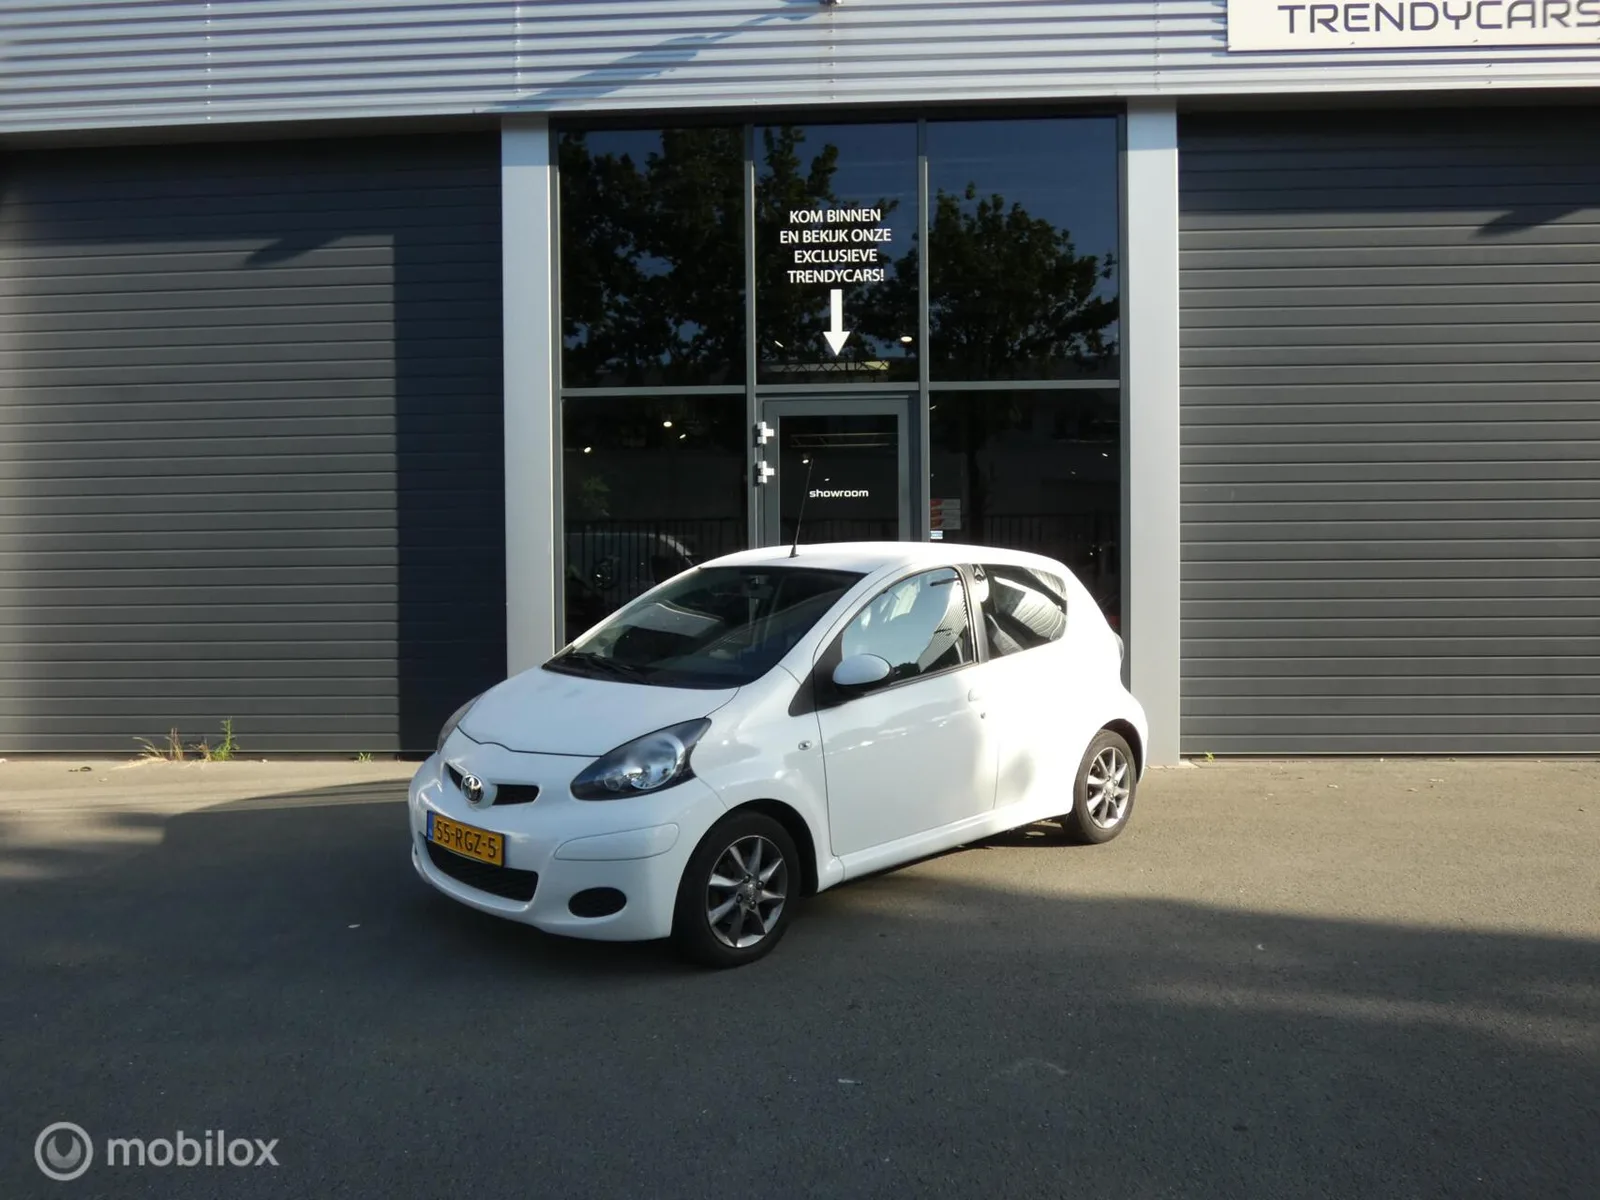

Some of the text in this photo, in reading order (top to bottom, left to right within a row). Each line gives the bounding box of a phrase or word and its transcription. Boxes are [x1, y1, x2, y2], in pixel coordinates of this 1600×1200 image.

[1277, 0, 1600, 34] TRENDYCARS
[789, 208, 881, 224] KOM BINNEN
[780, 228, 892, 244] EN BEKIJK ONZE
[794, 249, 878, 264] EXCLUSIEVE
[787, 268, 885, 284] TRENDYCARS!
[809, 488, 869, 498] showroom
[435, 819, 498, 859] 55-RGZ-5
